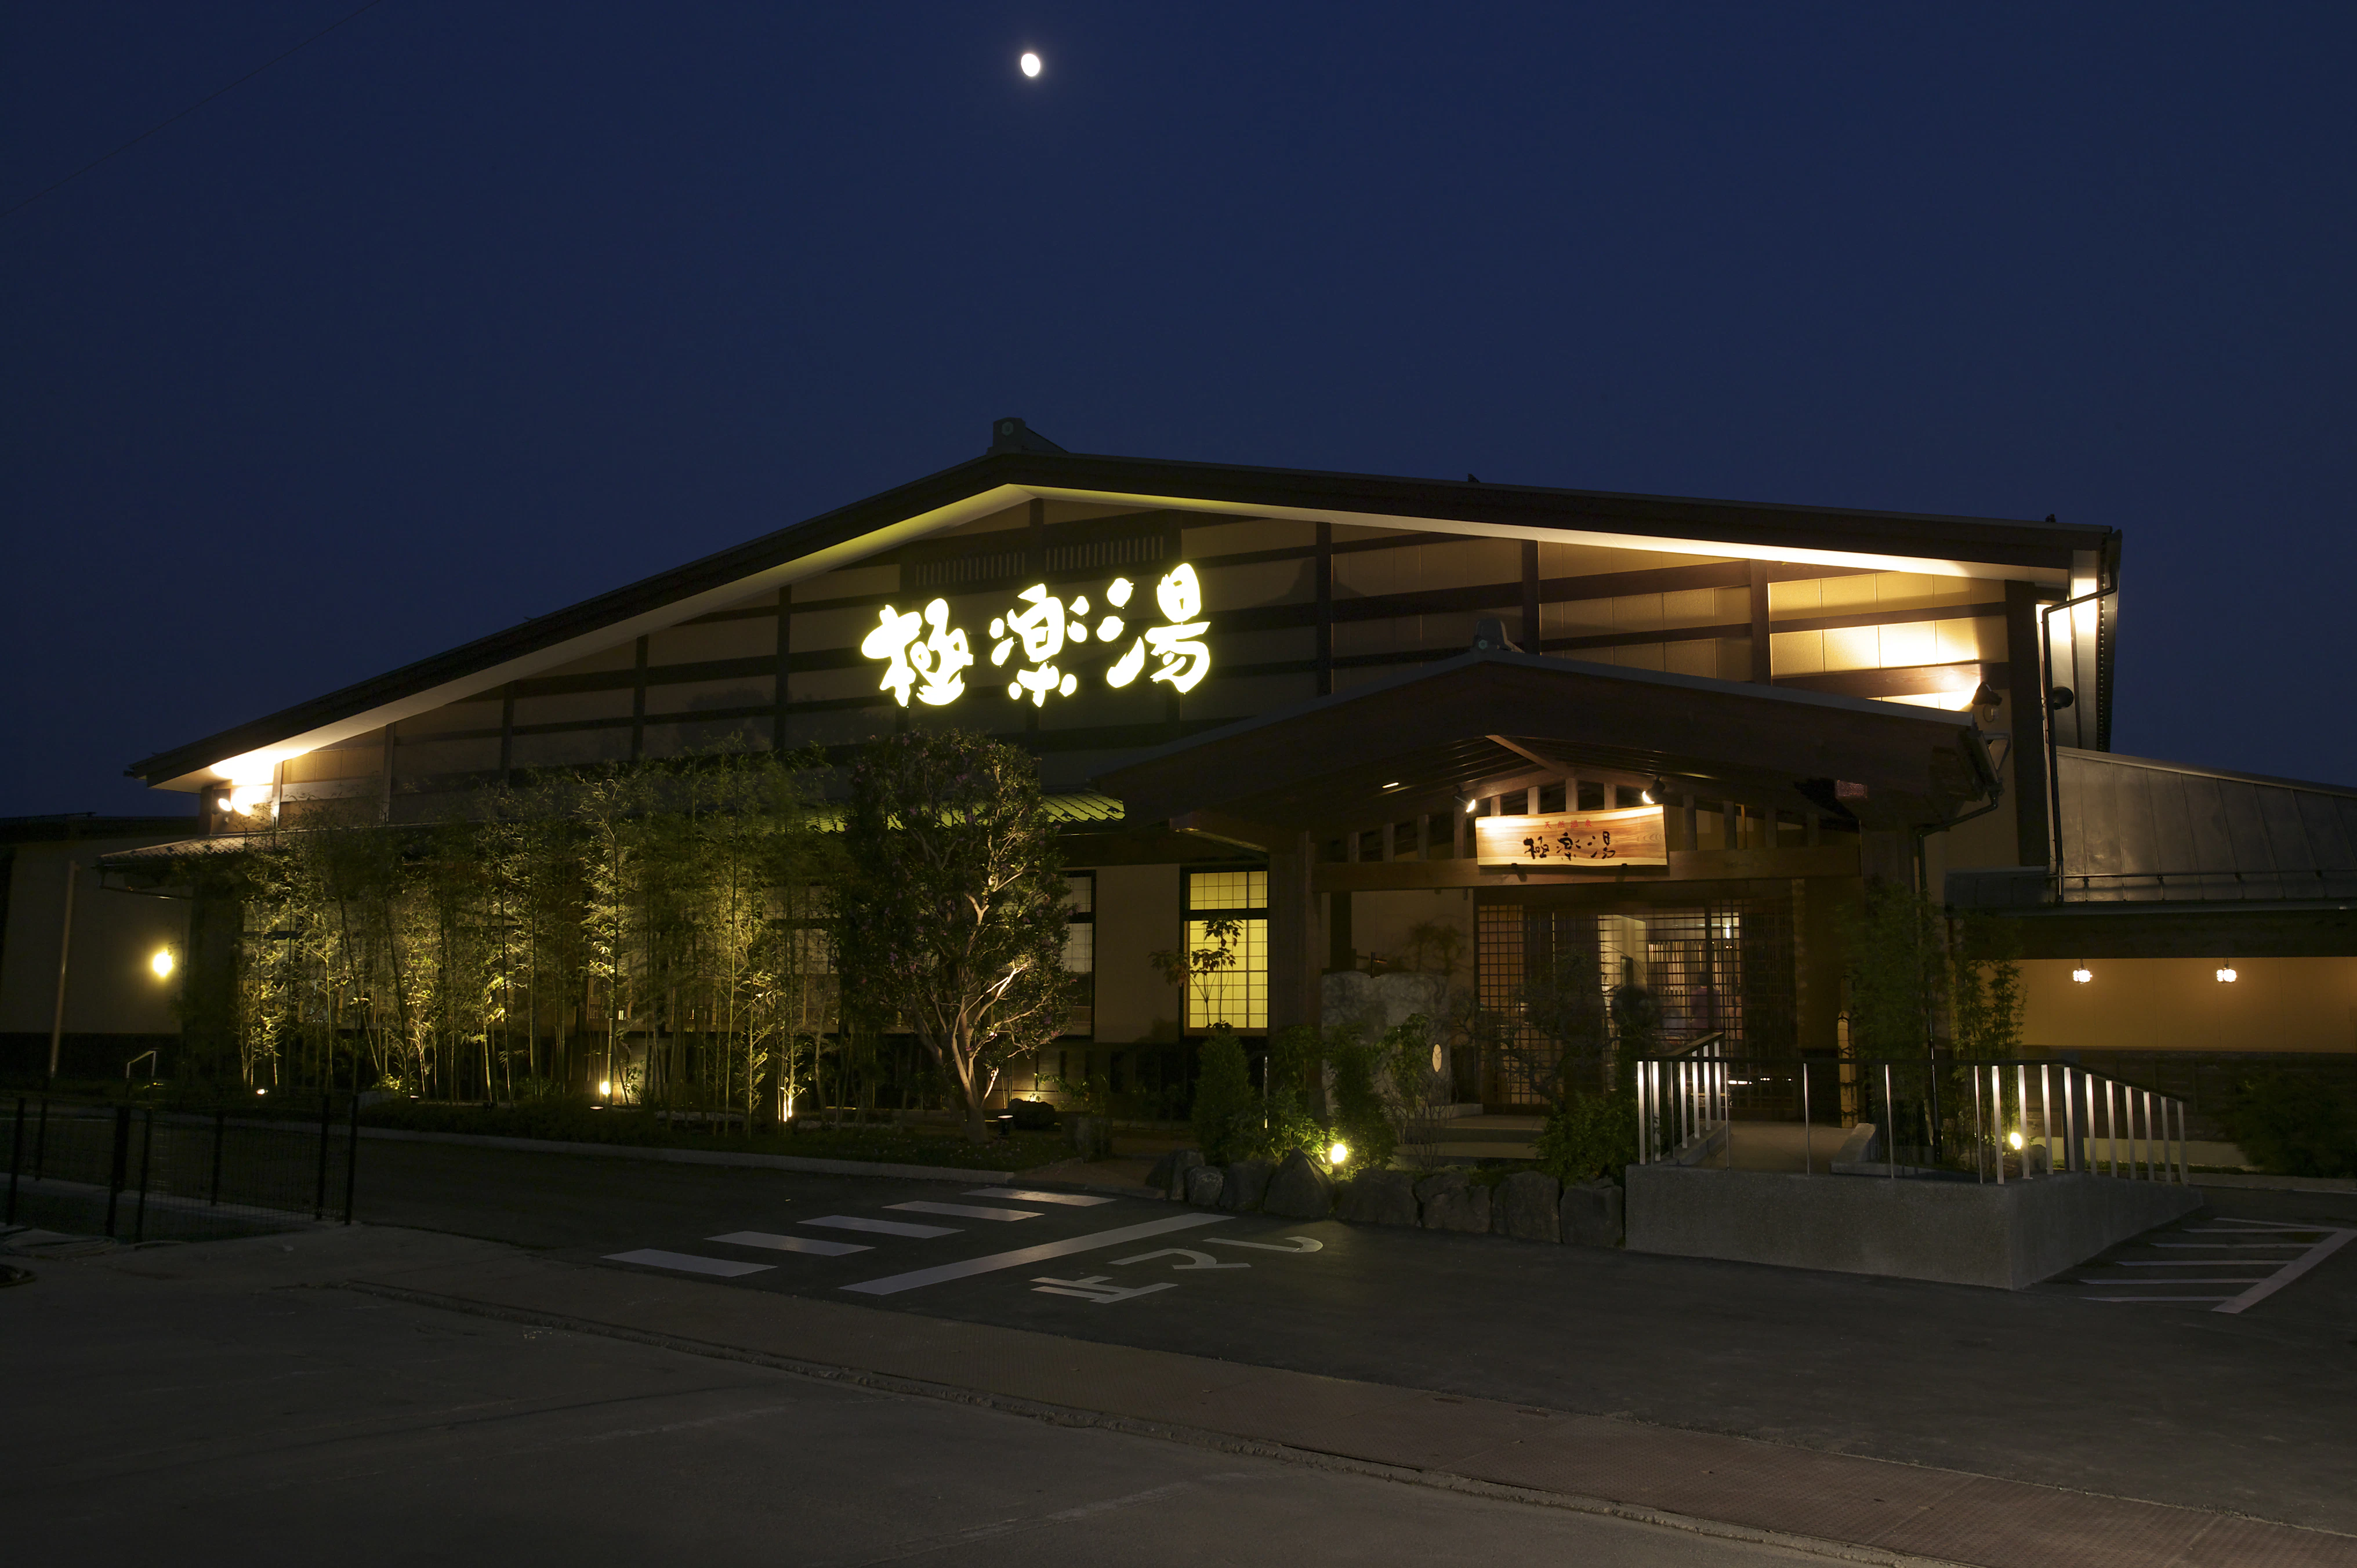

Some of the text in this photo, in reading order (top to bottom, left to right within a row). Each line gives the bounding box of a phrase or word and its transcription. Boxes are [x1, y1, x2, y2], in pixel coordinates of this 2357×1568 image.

[862, 563, 1210, 707] 極楽湯
[1544, 819, 1592, 829] 天然温泉
[1524, 831, 1616, 861] 極楽湯
